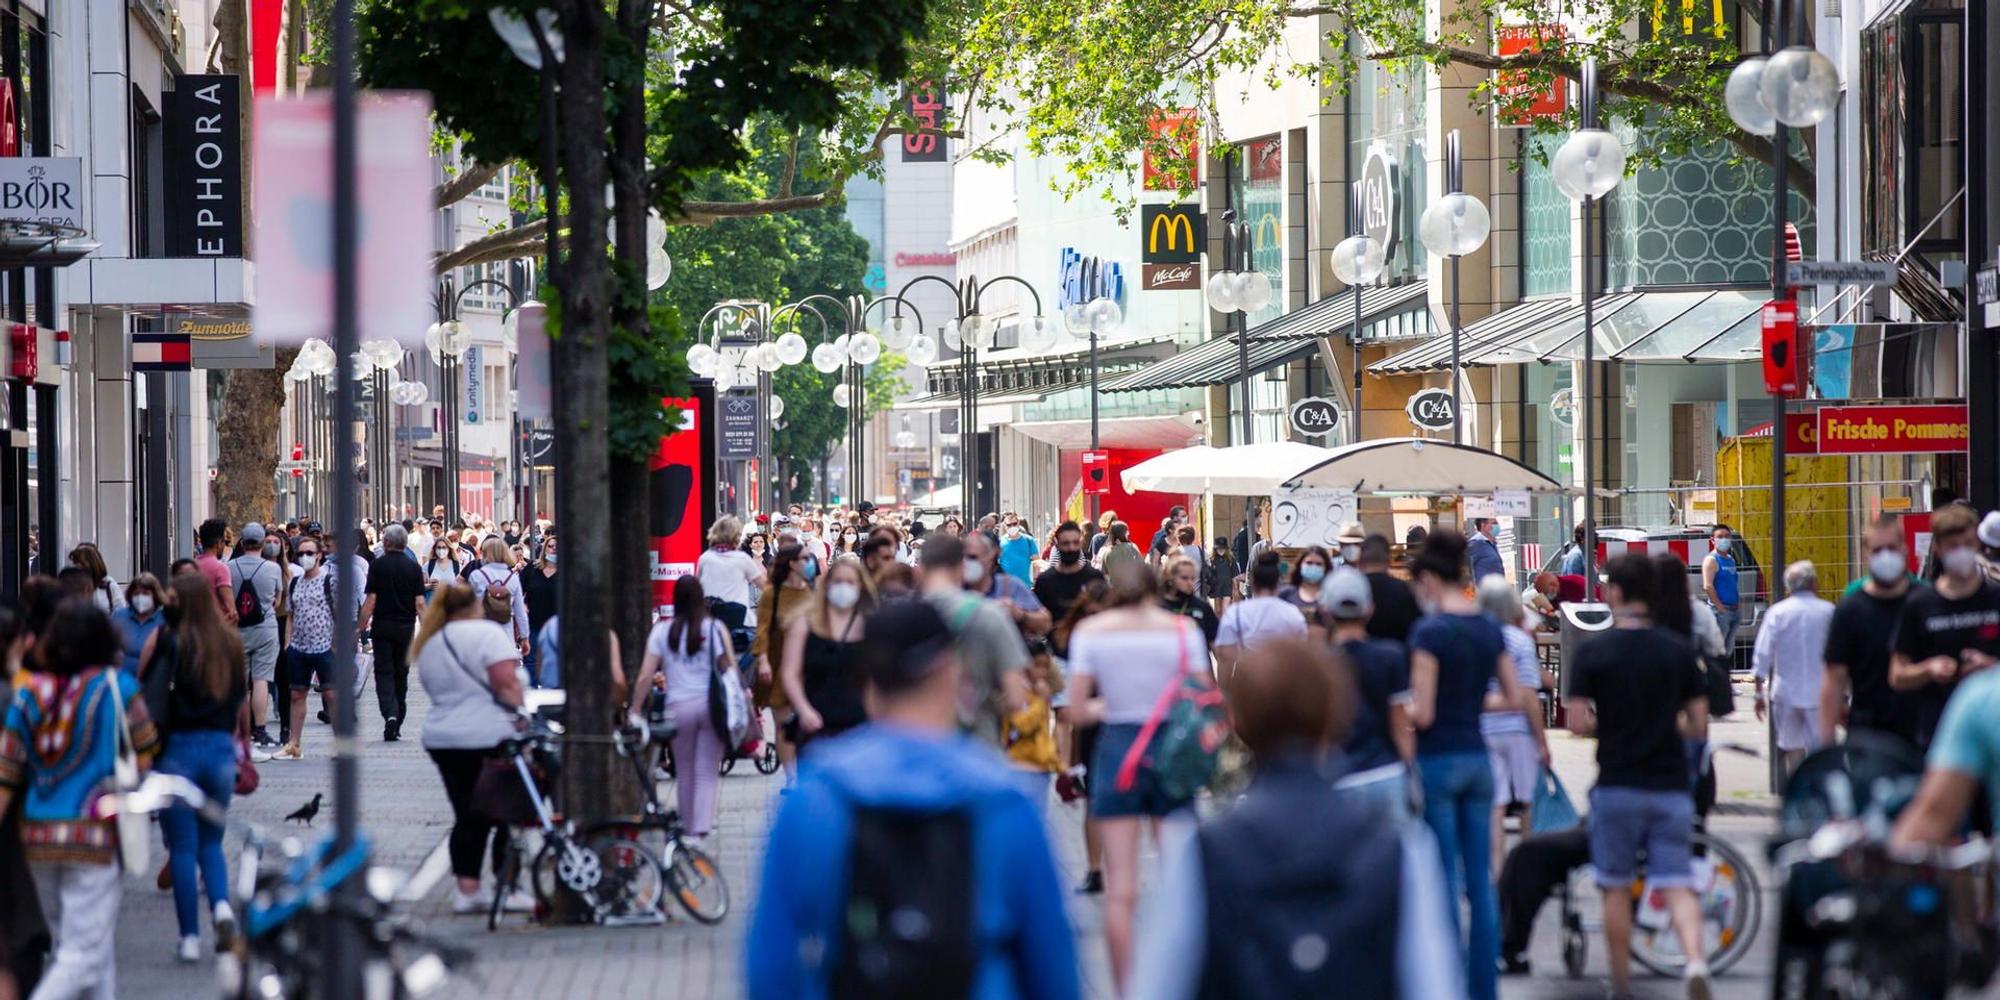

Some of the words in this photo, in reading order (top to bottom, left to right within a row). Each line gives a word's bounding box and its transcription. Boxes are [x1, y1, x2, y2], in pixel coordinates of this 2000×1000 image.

[904, 80, 942, 154] Sup
[195, 83, 224, 255] EPHORA
[1366, 176, 1387, 229] C&A
[467, 346, 479, 408] unitymedia
[1299, 407, 1334, 426] C&A
[1418, 399, 1454, 419] C&A
[1827, 417, 1889, 440] Frische
[1894, 418, 1968, 439] Pommes
